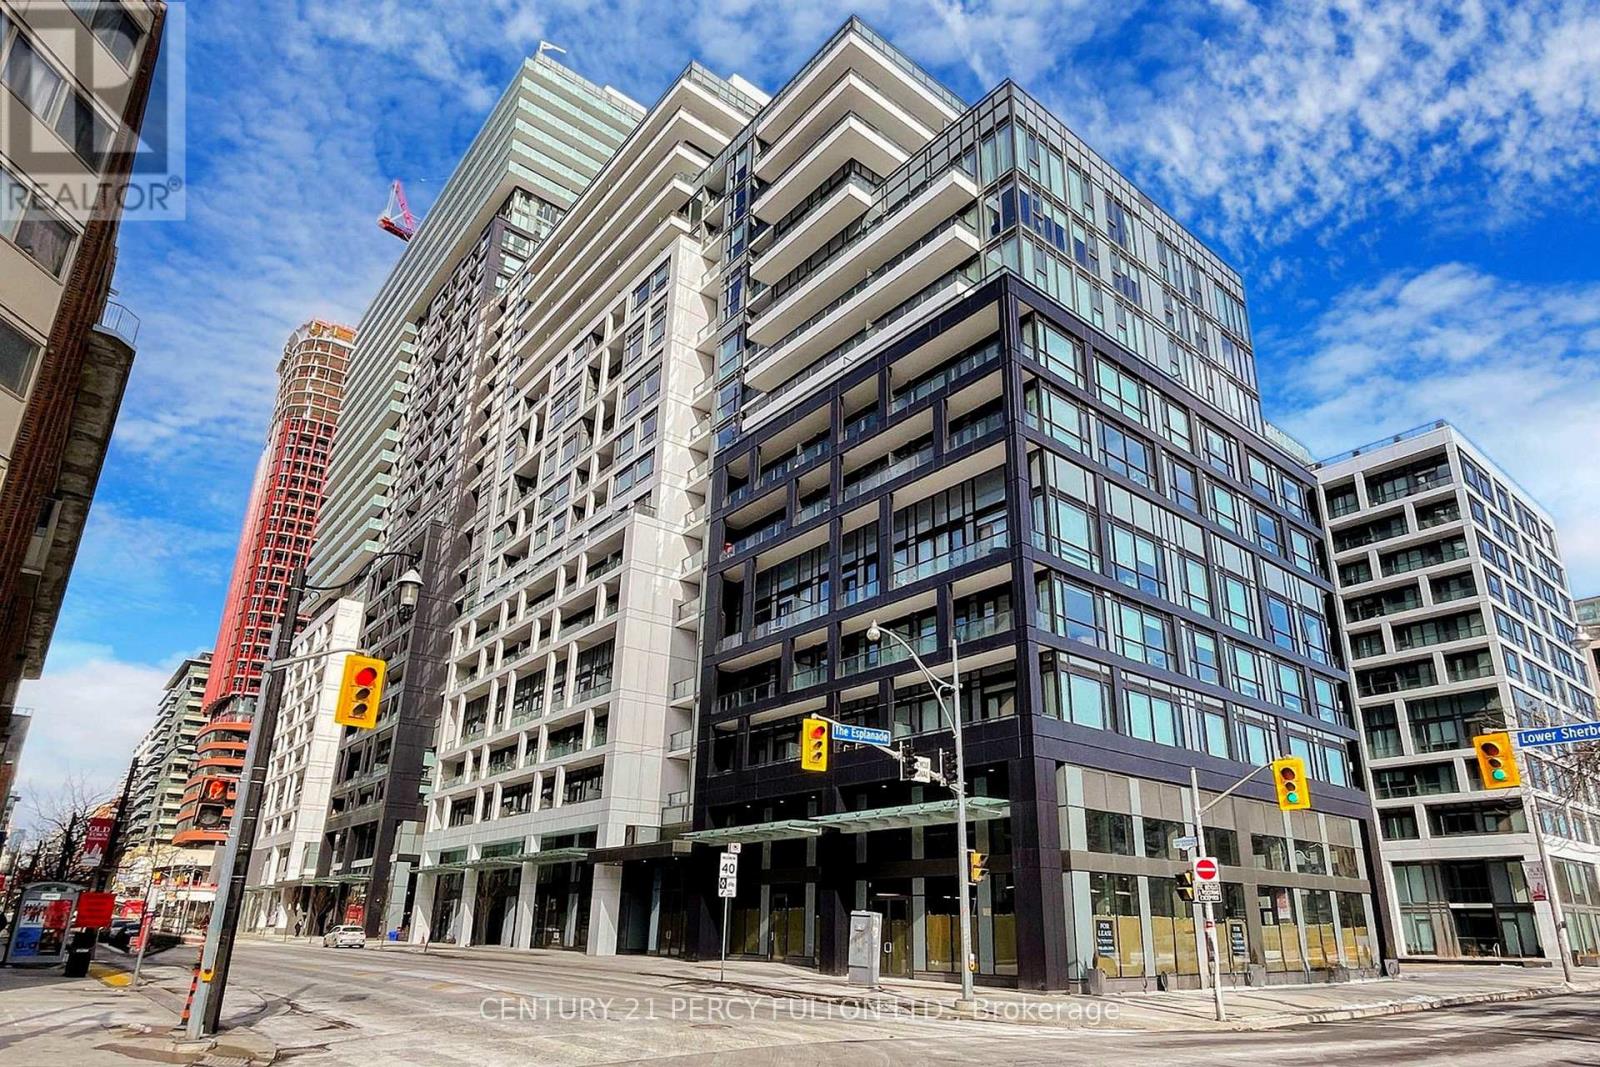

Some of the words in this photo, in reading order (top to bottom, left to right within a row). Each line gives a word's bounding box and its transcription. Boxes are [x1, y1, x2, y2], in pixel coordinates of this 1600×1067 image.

[835, 725, 849, 737] The
[851, 729, 889, 743] Esplanade
[1521, 731, 1557, 744] Lower
[89, 825, 111, 833] OLD
[721, 863, 736, 874] 40
